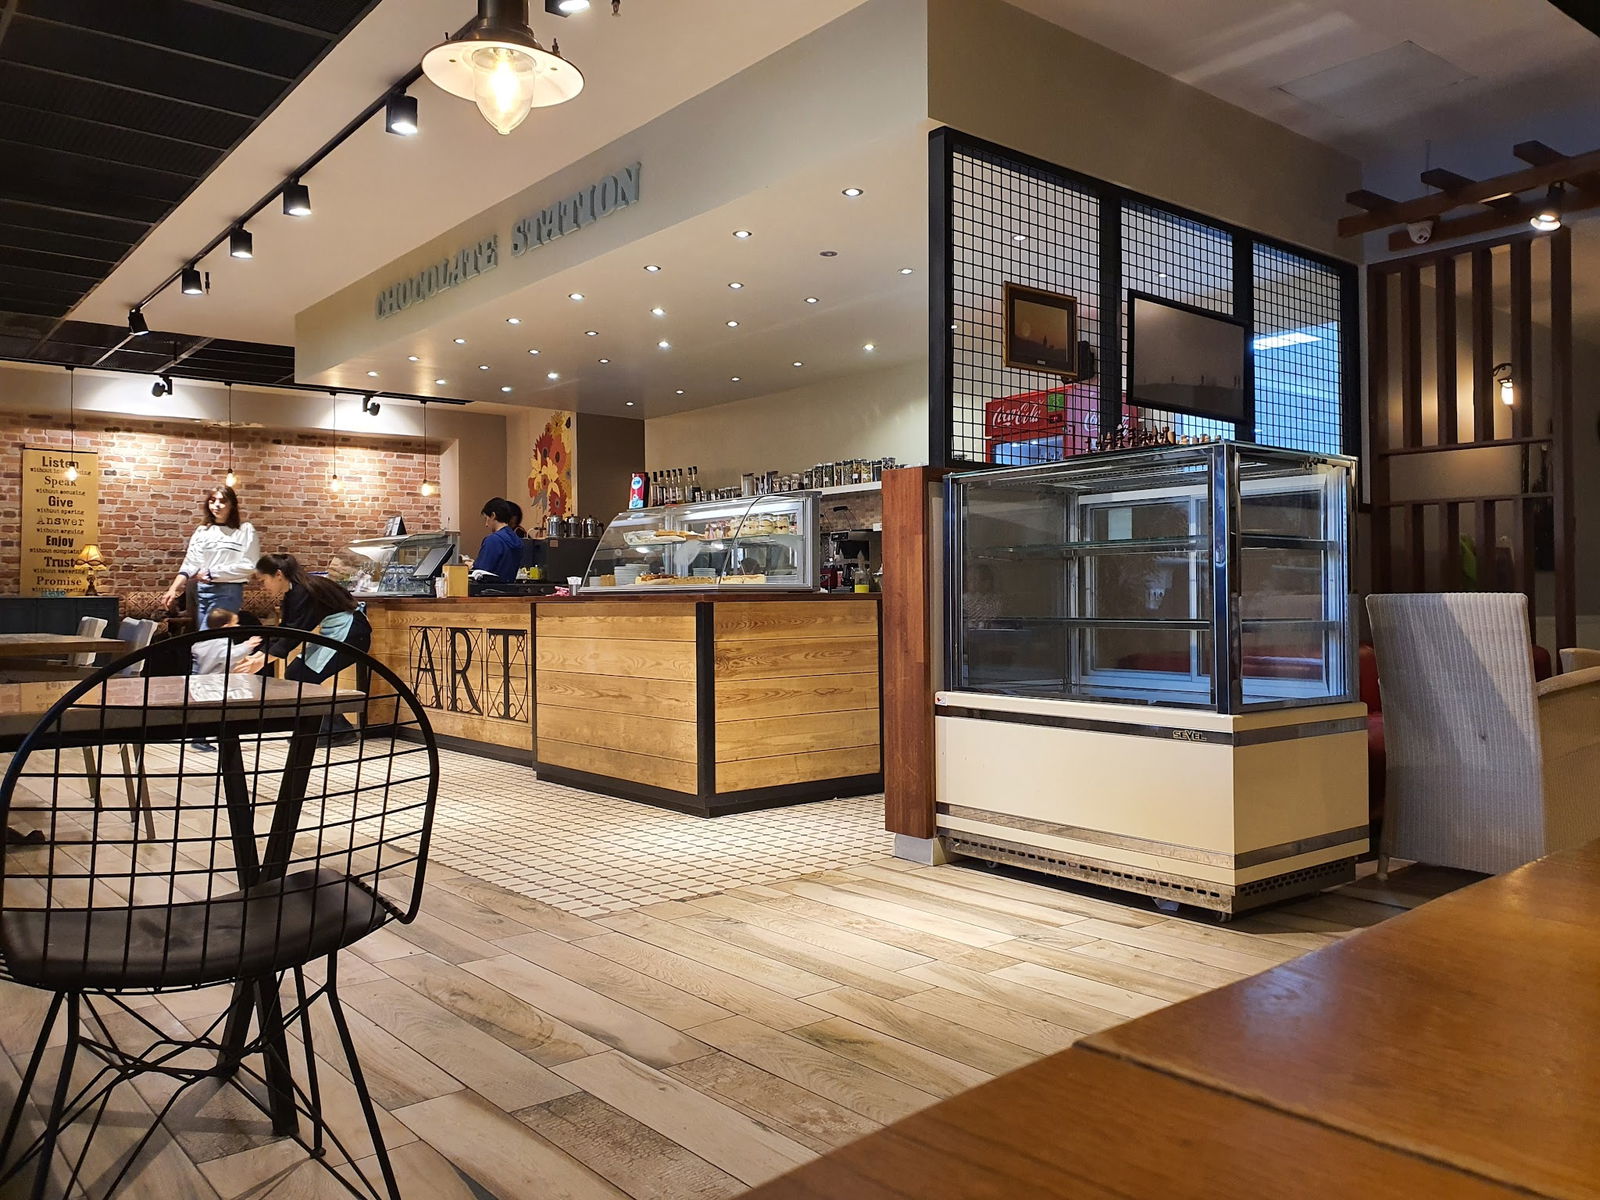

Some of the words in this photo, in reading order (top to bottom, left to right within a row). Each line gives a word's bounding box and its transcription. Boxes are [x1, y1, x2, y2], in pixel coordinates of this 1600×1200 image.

[375, 234, 498, 320] CHOCOLATE
[510, 160, 642, 257] STATION
[992, 399, 1044, 428] Coca-Cola
[48, 495, 74, 508] Give
[36, 515, 85, 527] Answer
[45, 535, 75, 548] Enjoy
[44, 556, 76, 568] Trust
[36, 575, 82, 586] Promise
[410, 626, 528, 722] ART
